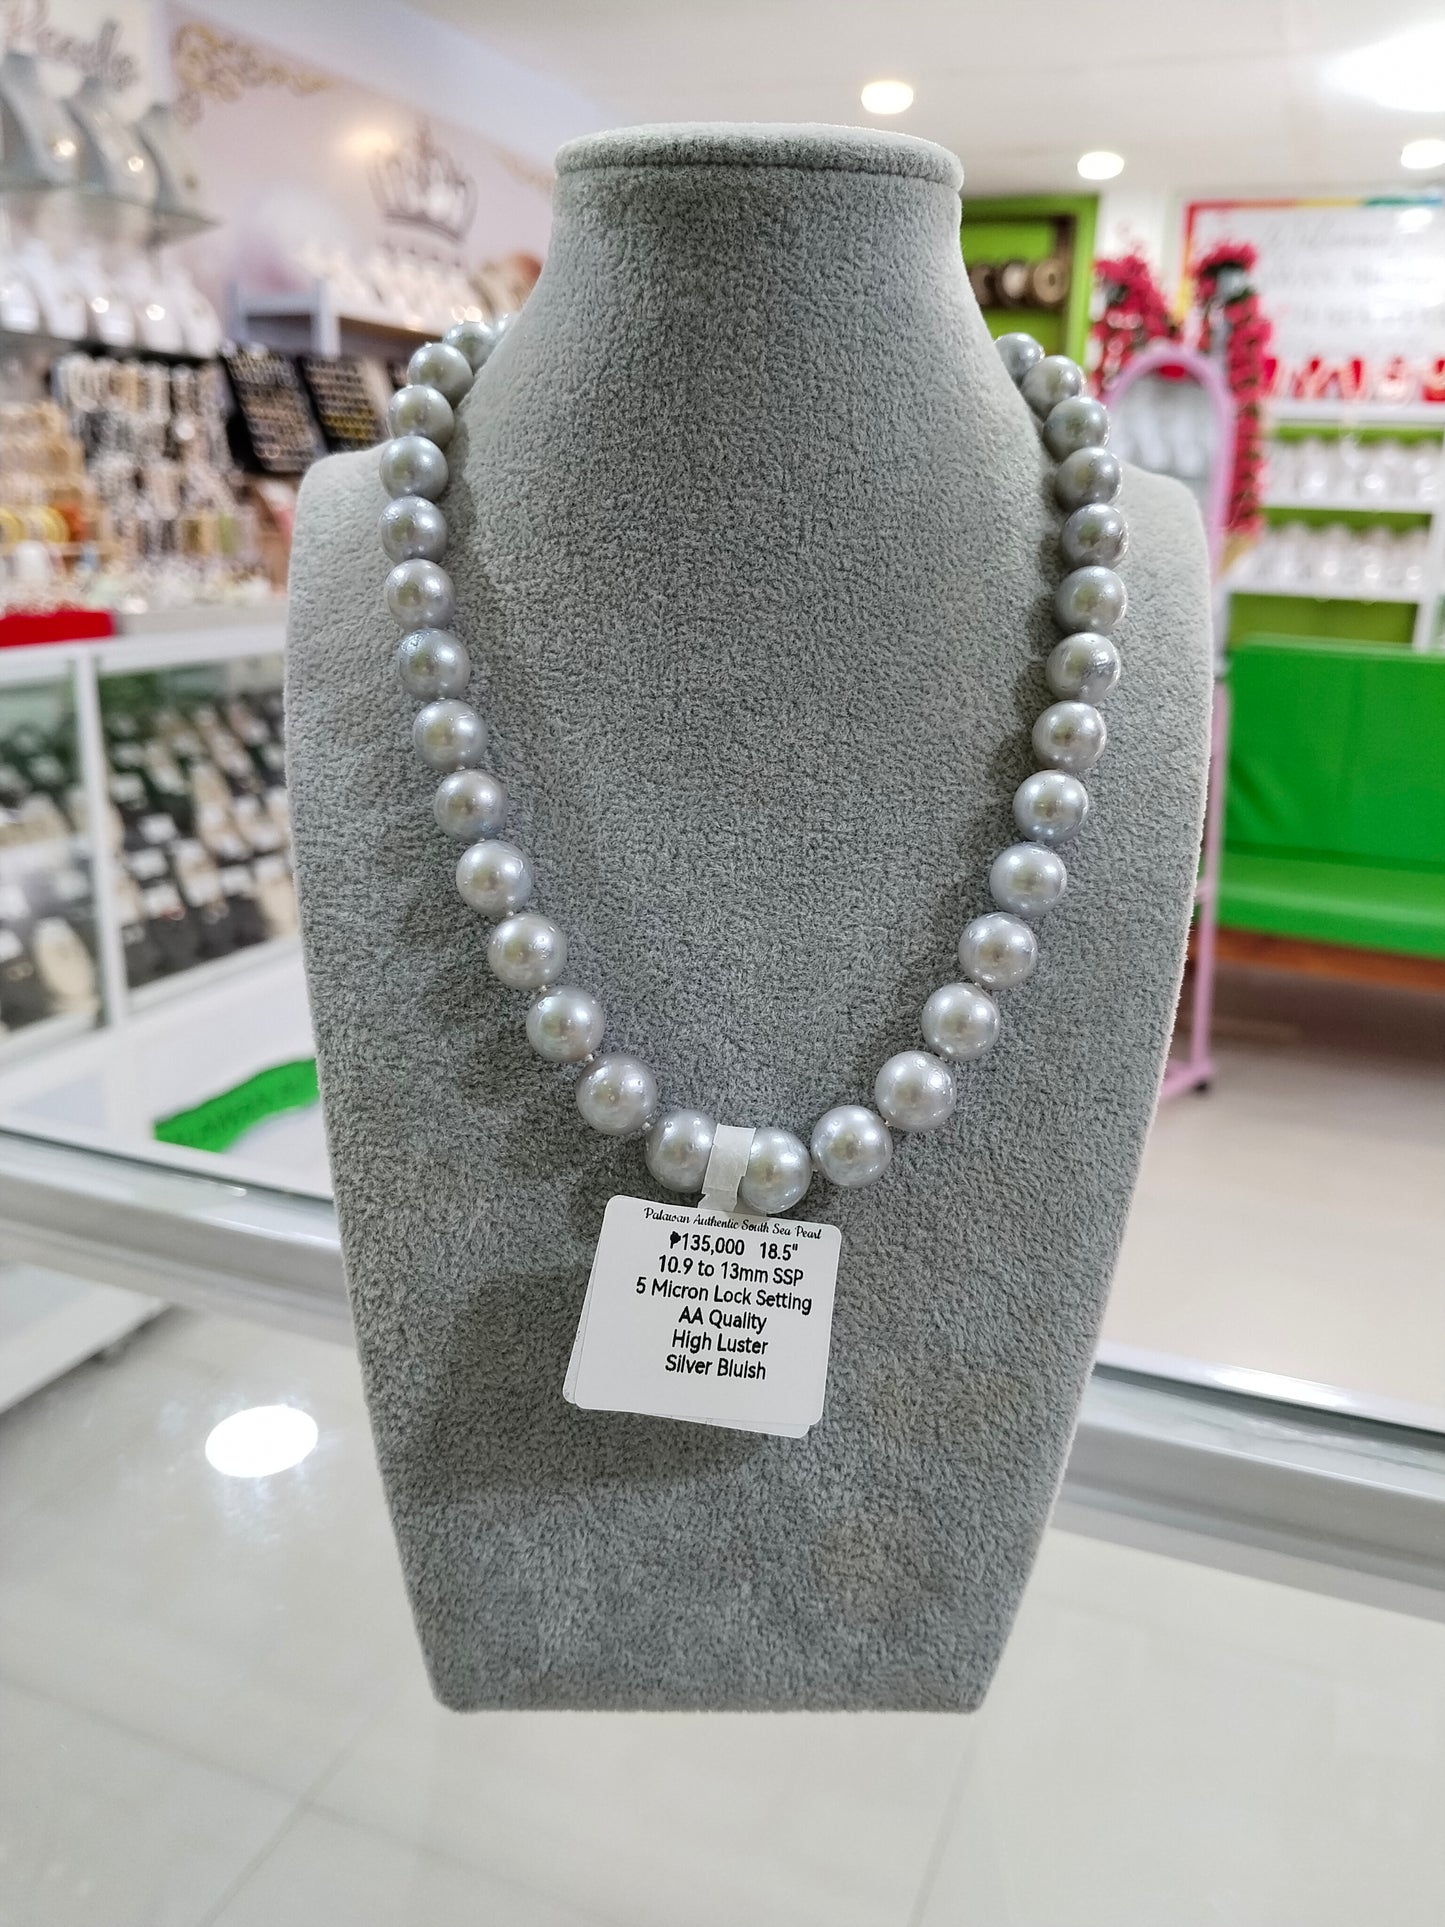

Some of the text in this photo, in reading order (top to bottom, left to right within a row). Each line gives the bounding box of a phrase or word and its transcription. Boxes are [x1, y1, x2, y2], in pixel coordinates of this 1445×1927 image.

[643, 1207, 822, 1240] Palawan Authentic South Sea Pearl
[759, 1242, 799, 1261] 18.5"
[658, 1254, 804, 1287] 10.9 to 13mm SSP
[635, 1276, 813, 1316] 5 Micron Lock Setting
[678, 1305, 768, 1335] AA Quality
[671, 1328, 769, 1355] High Luster
[664, 1353, 767, 1380] Silver Bluish
